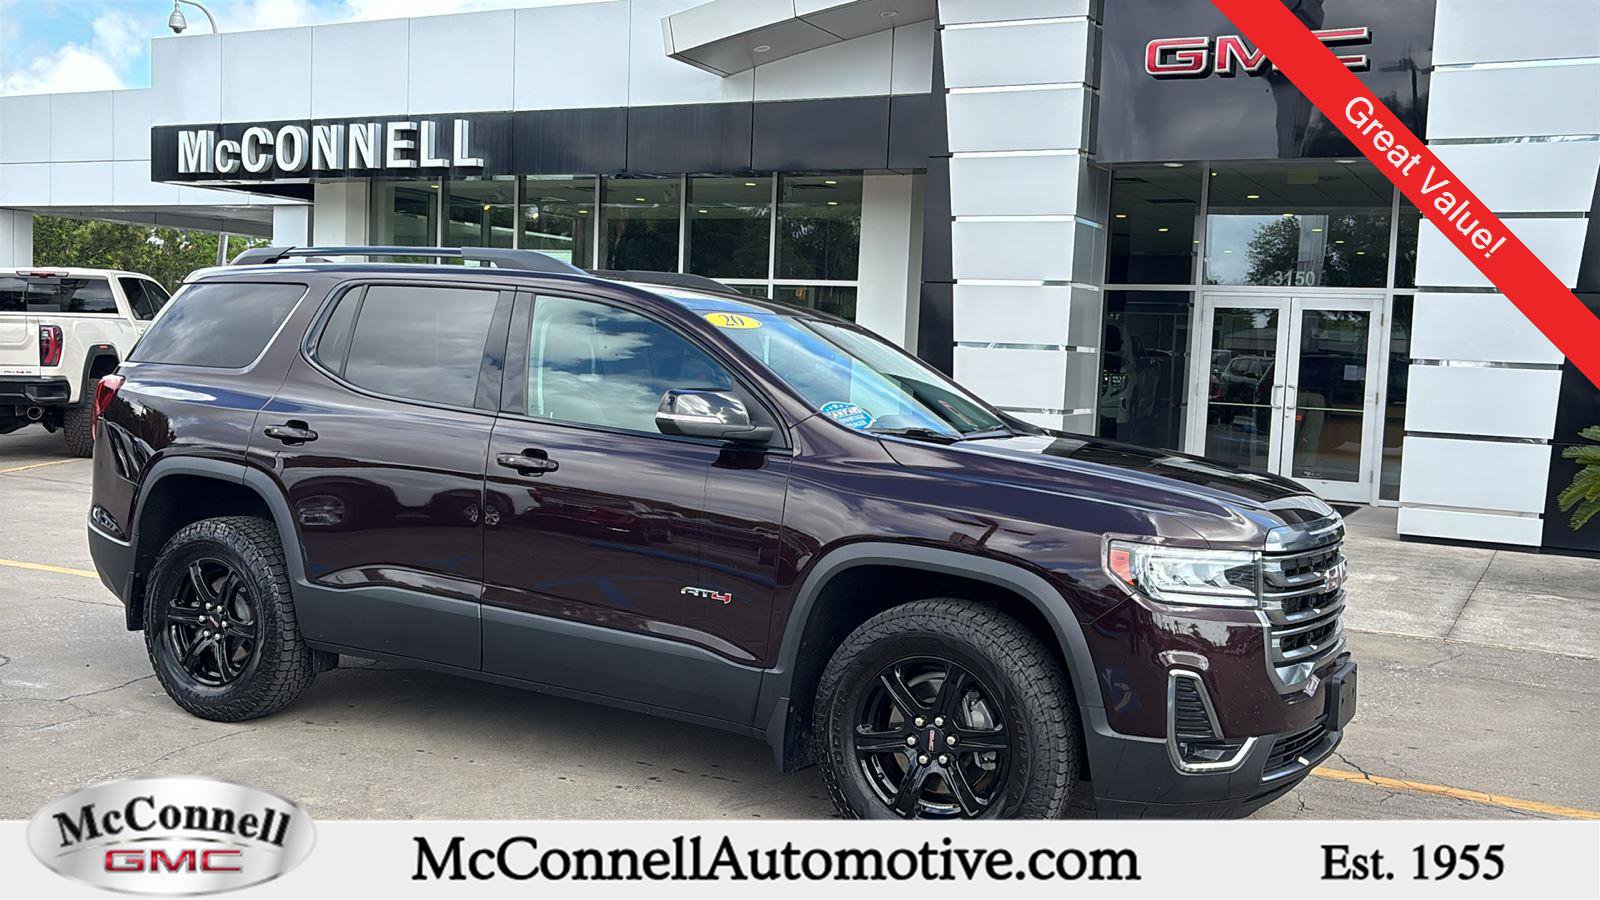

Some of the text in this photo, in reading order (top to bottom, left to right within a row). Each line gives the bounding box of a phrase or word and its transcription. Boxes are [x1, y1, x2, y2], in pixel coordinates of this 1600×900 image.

[178, 119, 484, 174] McCONNELL
[1273, 269, 1316, 286] 3150
[718, 314, 744, 327] 20
[680, 586, 732, 604] AT4
